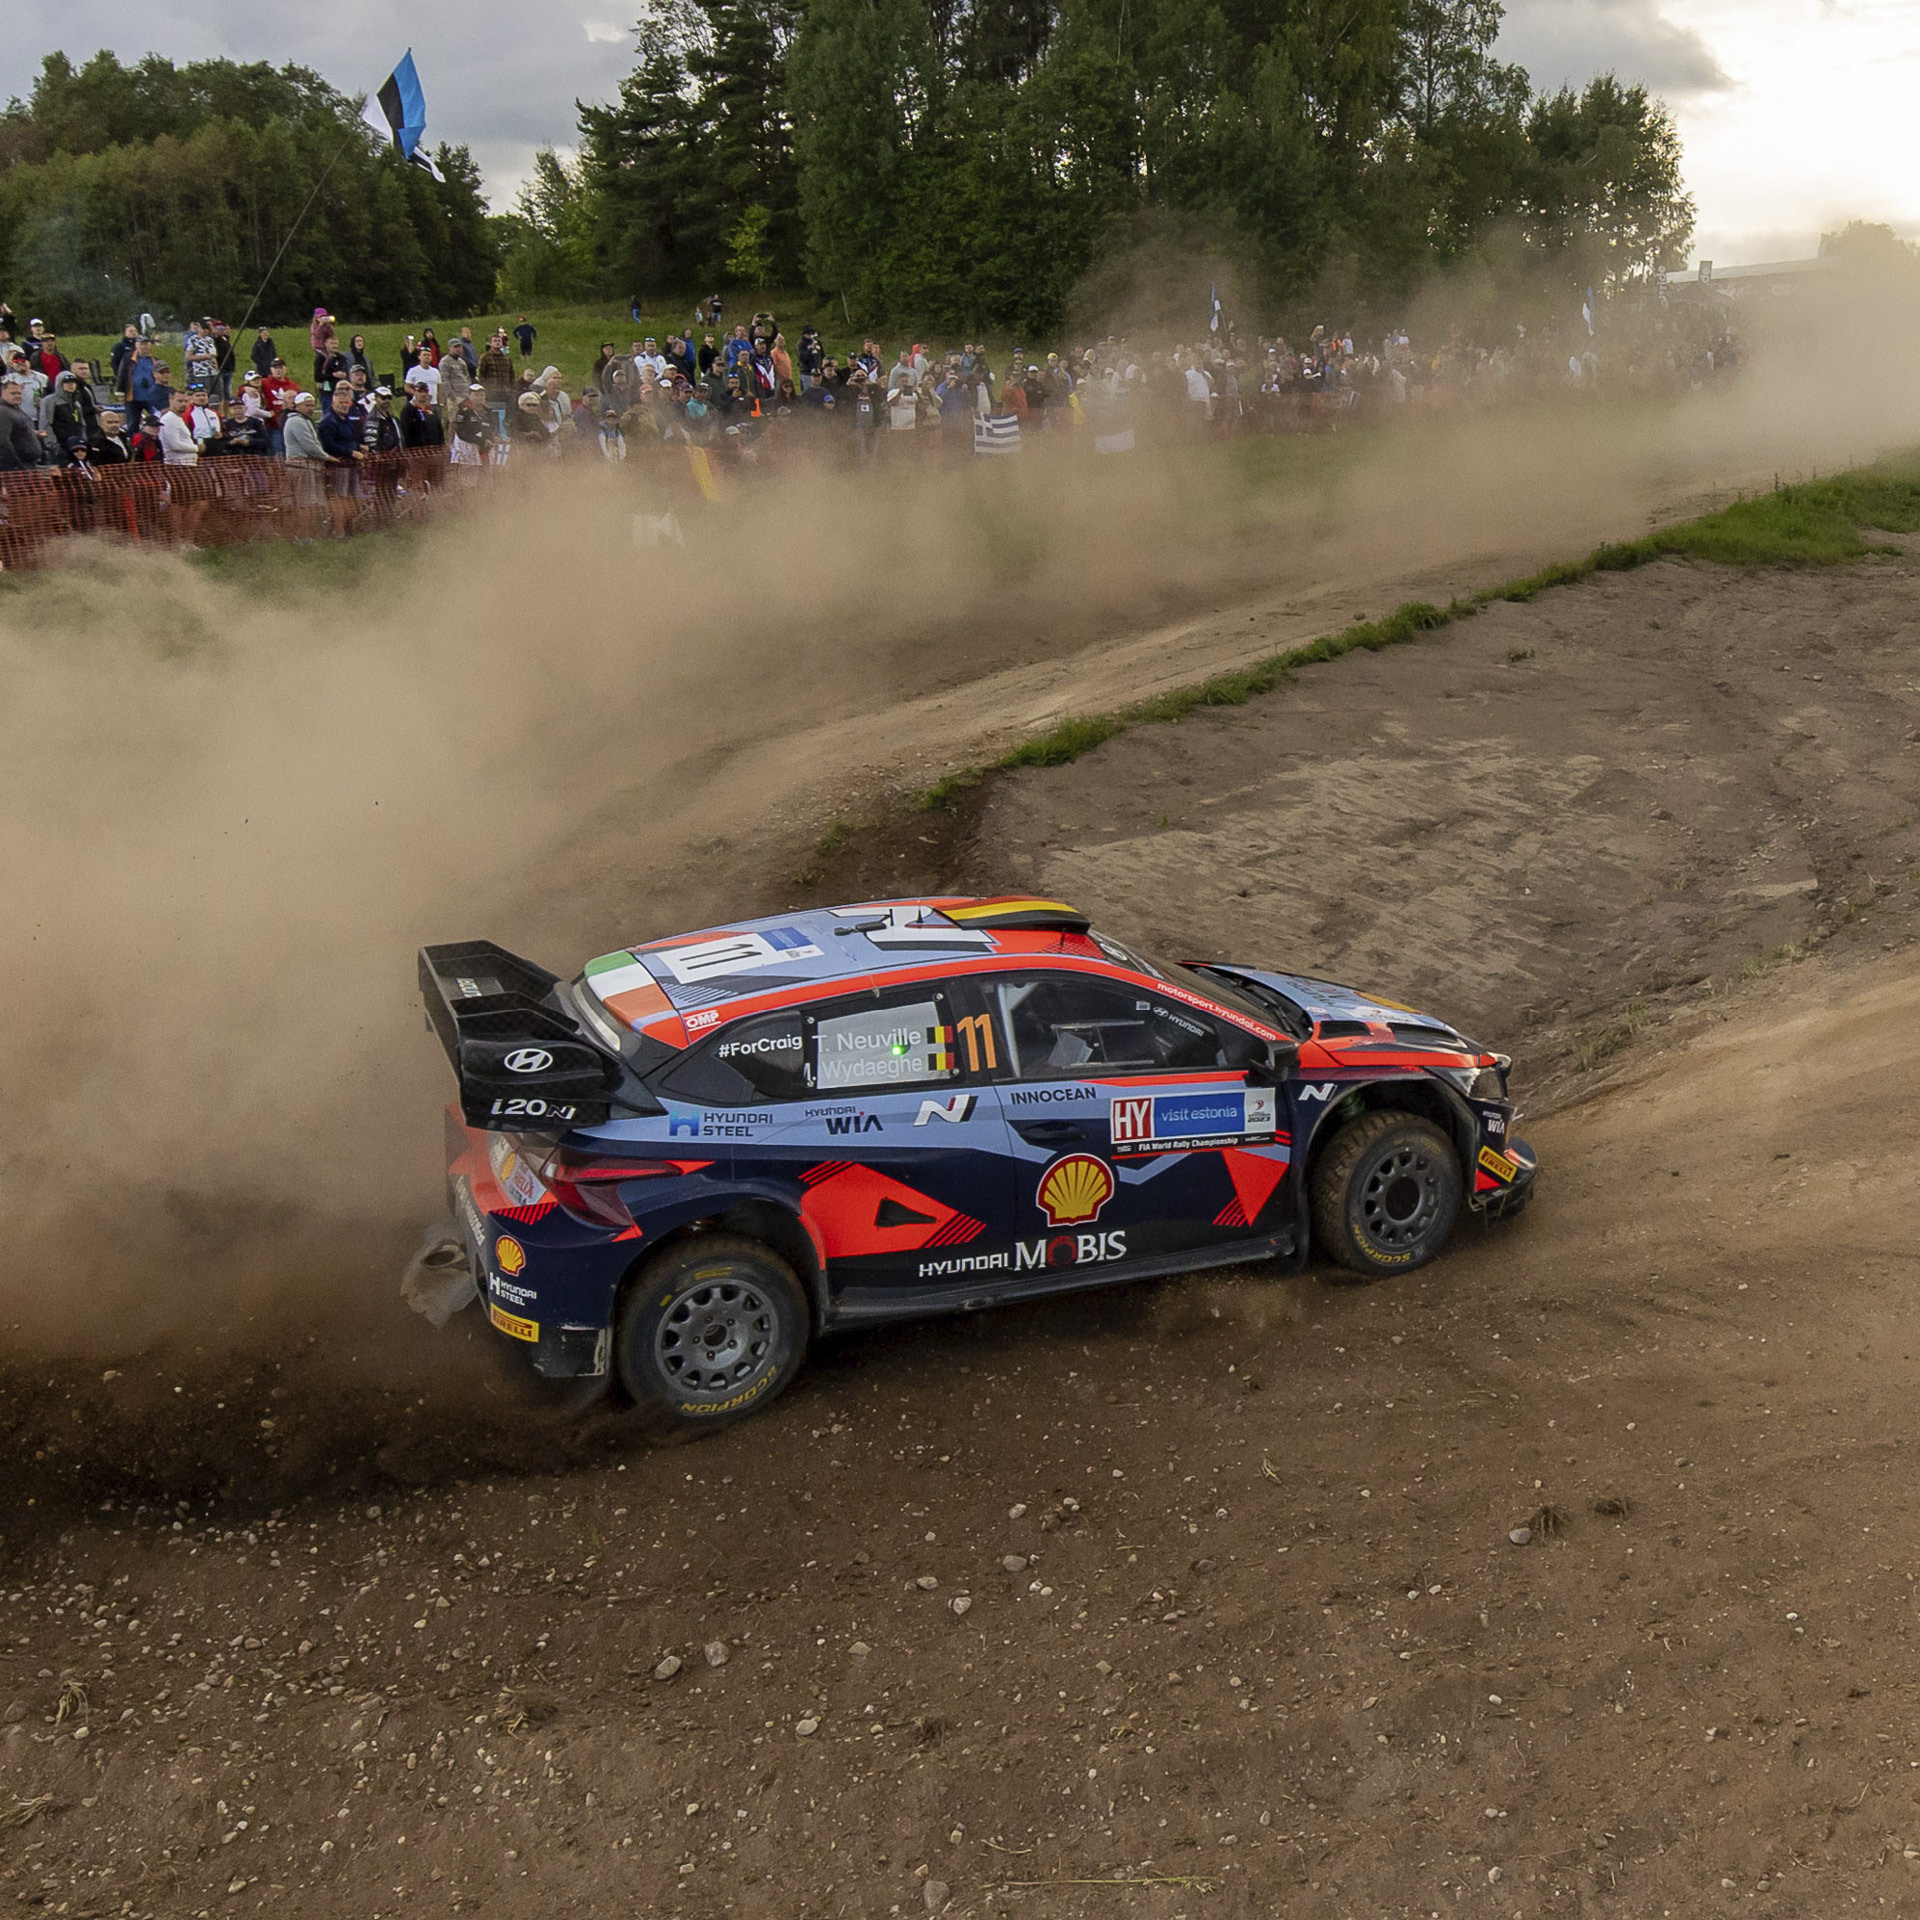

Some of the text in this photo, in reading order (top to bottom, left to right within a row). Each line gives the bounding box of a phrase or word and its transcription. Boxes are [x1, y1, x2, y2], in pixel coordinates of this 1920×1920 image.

[685, 1011, 720, 1030] OMP
[1156, 982, 1276, 1041] motorsport.hyundai.com
[1168, 1013, 1205, 1037] HYUNDAI
[718, 1033, 803, 1059] #ForCraig
[811, 1027, 922, 1053] T. Neuville
[957, 1013, 997, 1072] 11
[822, 1056, 923, 1082] Wydaeghe
[1010, 1087, 1097, 1105] INNOCEAN
[703, 1112, 773, 1125] HYUNDAI
[805, 1106, 856, 1117] HYUNDAI
[826, 1110, 884, 1135] WIA
[1114, 1100, 1150, 1139] HY
[1161, 1105, 1238, 1122] visit estonia
[703, 1125, 754, 1137] STEEL
[1138, 1142, 1151, 1151] FIA
[1152, 1140, 1172, 1150] World
[1173, 1139, 1190, 1150] Rally
[1191, 1137, 1238, 1148] Championship
[1481, 1150, 1514, 1178] PIRELLI
[918, 1230, 1127, 1278] HYUNDAI MOBIS
[1352, 1223, 1411, 1264] SCORPION
[500, 1280, 537, 1300] HYUNDAI
[500, 1289, 526, 1306] STEEL
[492, 1307, 533, 1338] PIRELLI
[681, 1365, 777, 1413] SCORPION
